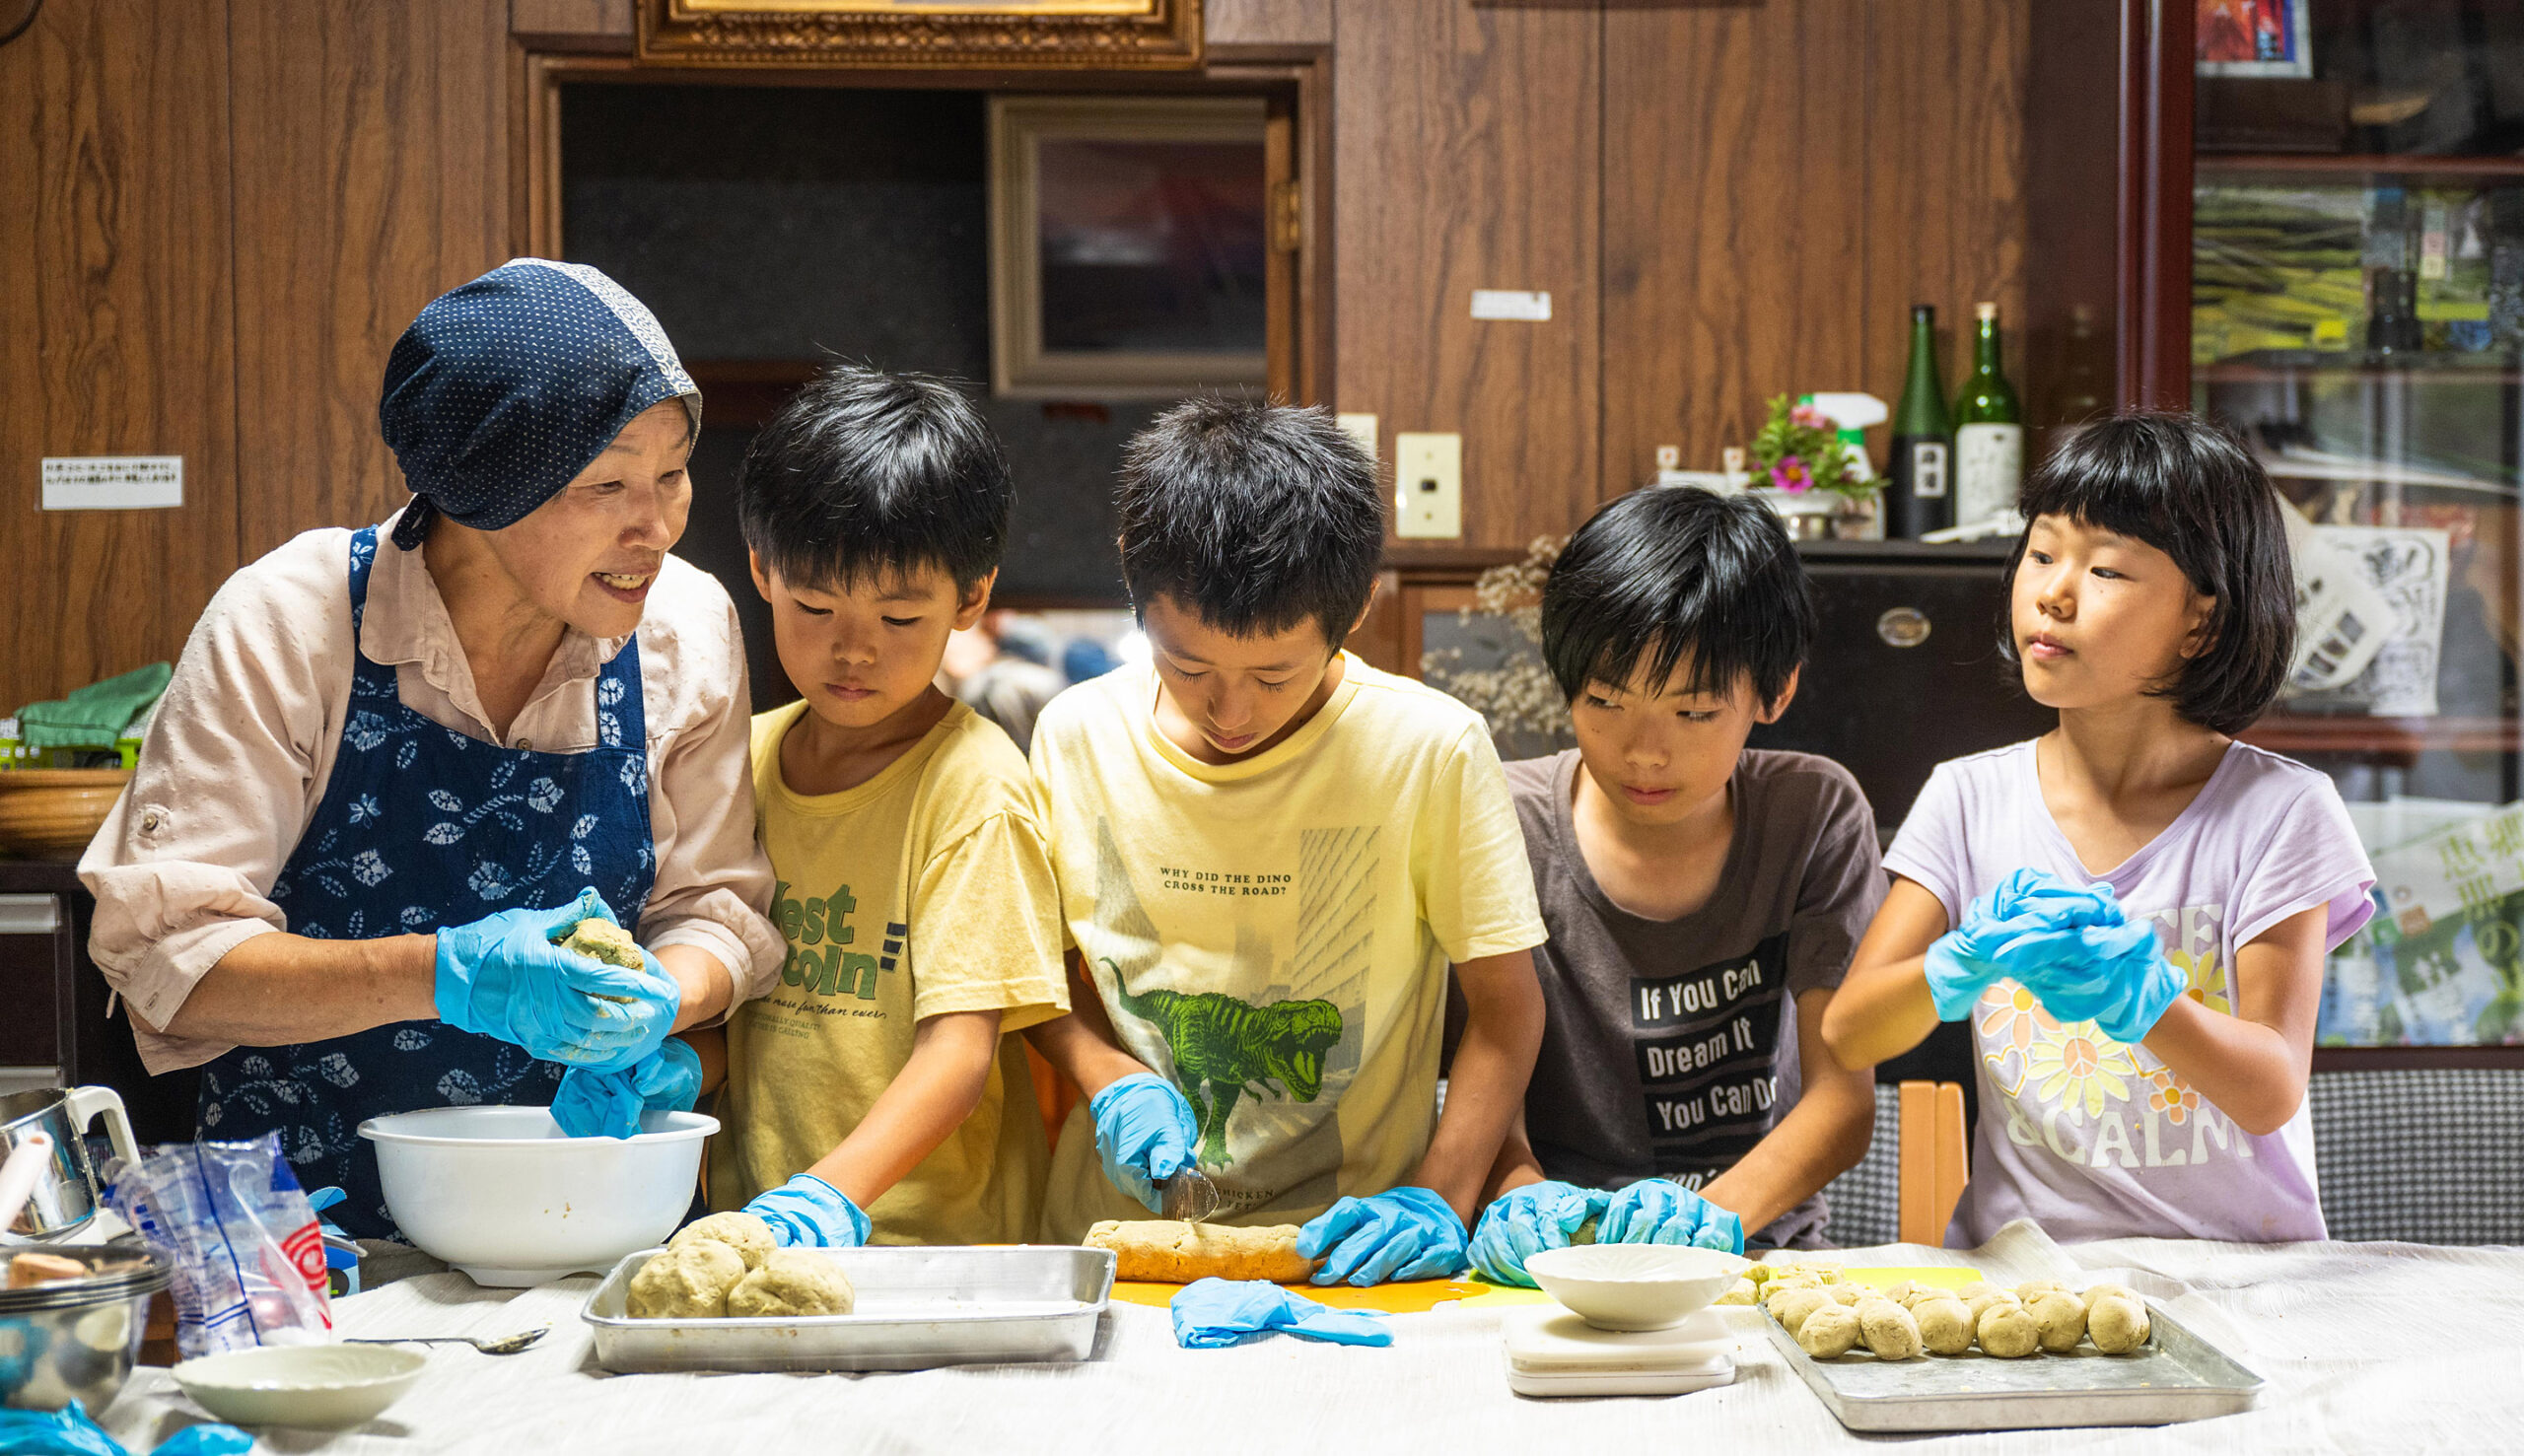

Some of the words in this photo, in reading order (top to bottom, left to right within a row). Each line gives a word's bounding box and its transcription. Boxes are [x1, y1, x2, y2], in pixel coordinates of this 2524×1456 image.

[1159, 867, 1189, 878] WHY
[1195, 871, 1219, 882] DID
[1225, 873, 1250, 883] THE
[1256, 873, 1292, 884] DINO
[1163, 880, 1205, 892] CROSS
[1210, 885, 1235, 895] THE
[1242, 886, 1287, 896] ROAD?
[1641, 987, 1661, 1020] If
[1668, 977, 1718, 1016] You
[1722, 958, 1762, 1001] Can
[1647, 1032, 1728, 1077] Dream
[1732, 1016, 1755, 1052] It
[1656, 1097, 1705, 1131] You
[1710, 1085, 1752, 1117] Can
